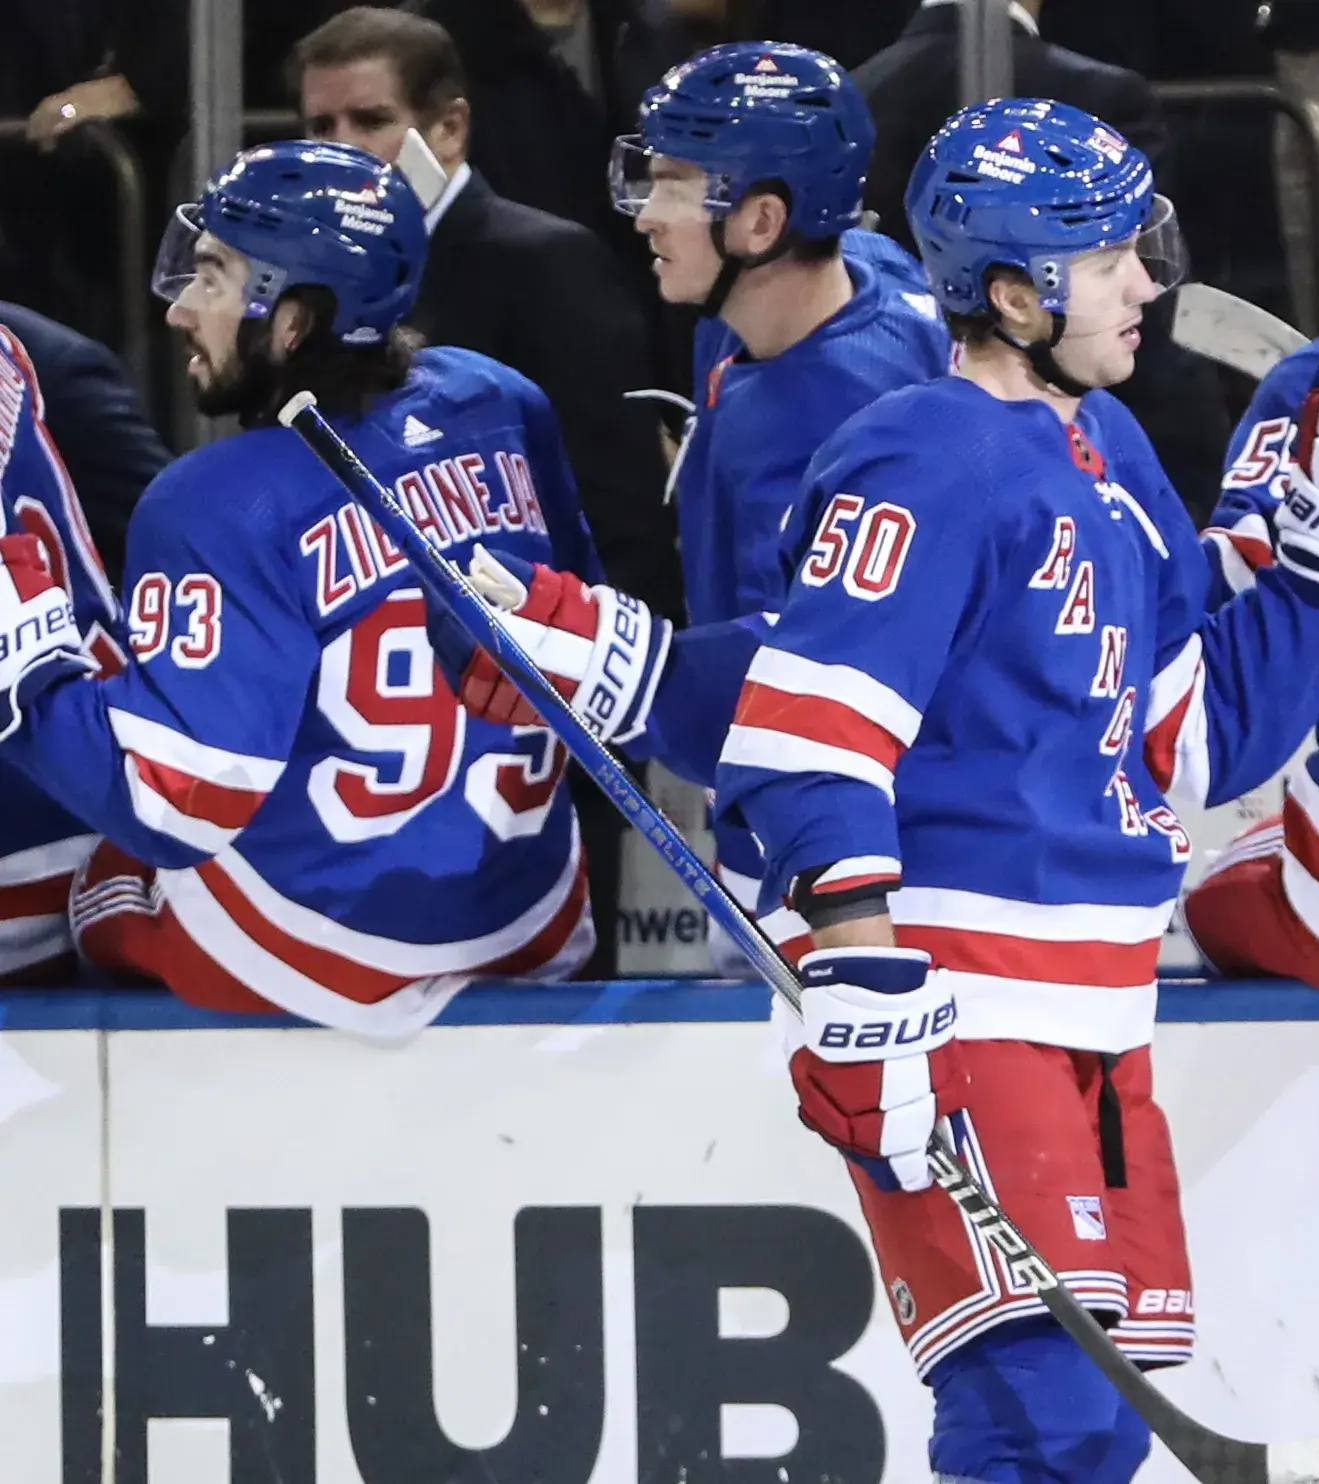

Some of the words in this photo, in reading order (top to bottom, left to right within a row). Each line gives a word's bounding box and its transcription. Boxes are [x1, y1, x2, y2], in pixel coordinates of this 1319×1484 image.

[973, 144, 1037, 174] Benjamin
[977, 160, 1027, 184] Moore
[802, 493, 917, 601] 50
[128, 571, 222, 670] 93
[59, 1204, 888, 1484] HUB
